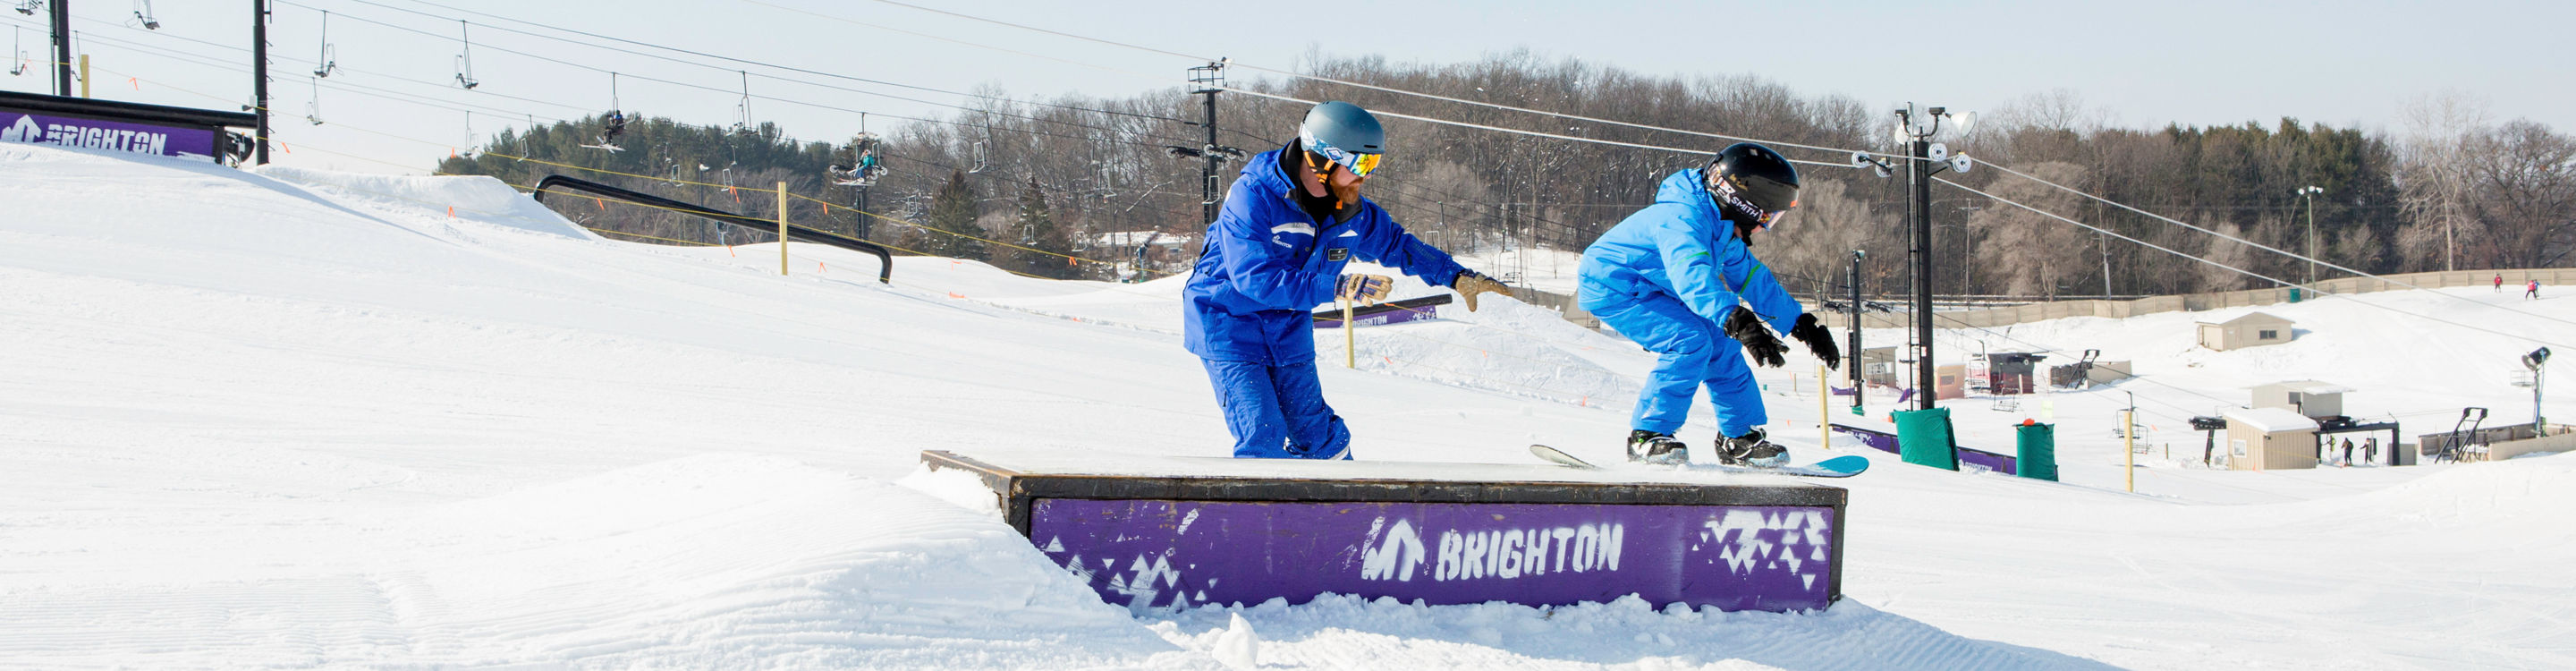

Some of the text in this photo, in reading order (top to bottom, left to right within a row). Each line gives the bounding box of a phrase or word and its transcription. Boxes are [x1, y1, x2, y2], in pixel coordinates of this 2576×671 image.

[47, 123, 167, 156] BRIGHTON
[1732, 196, 1758, 217] SMITH
[1434, 523, 1623, 582] BRIGHTON
